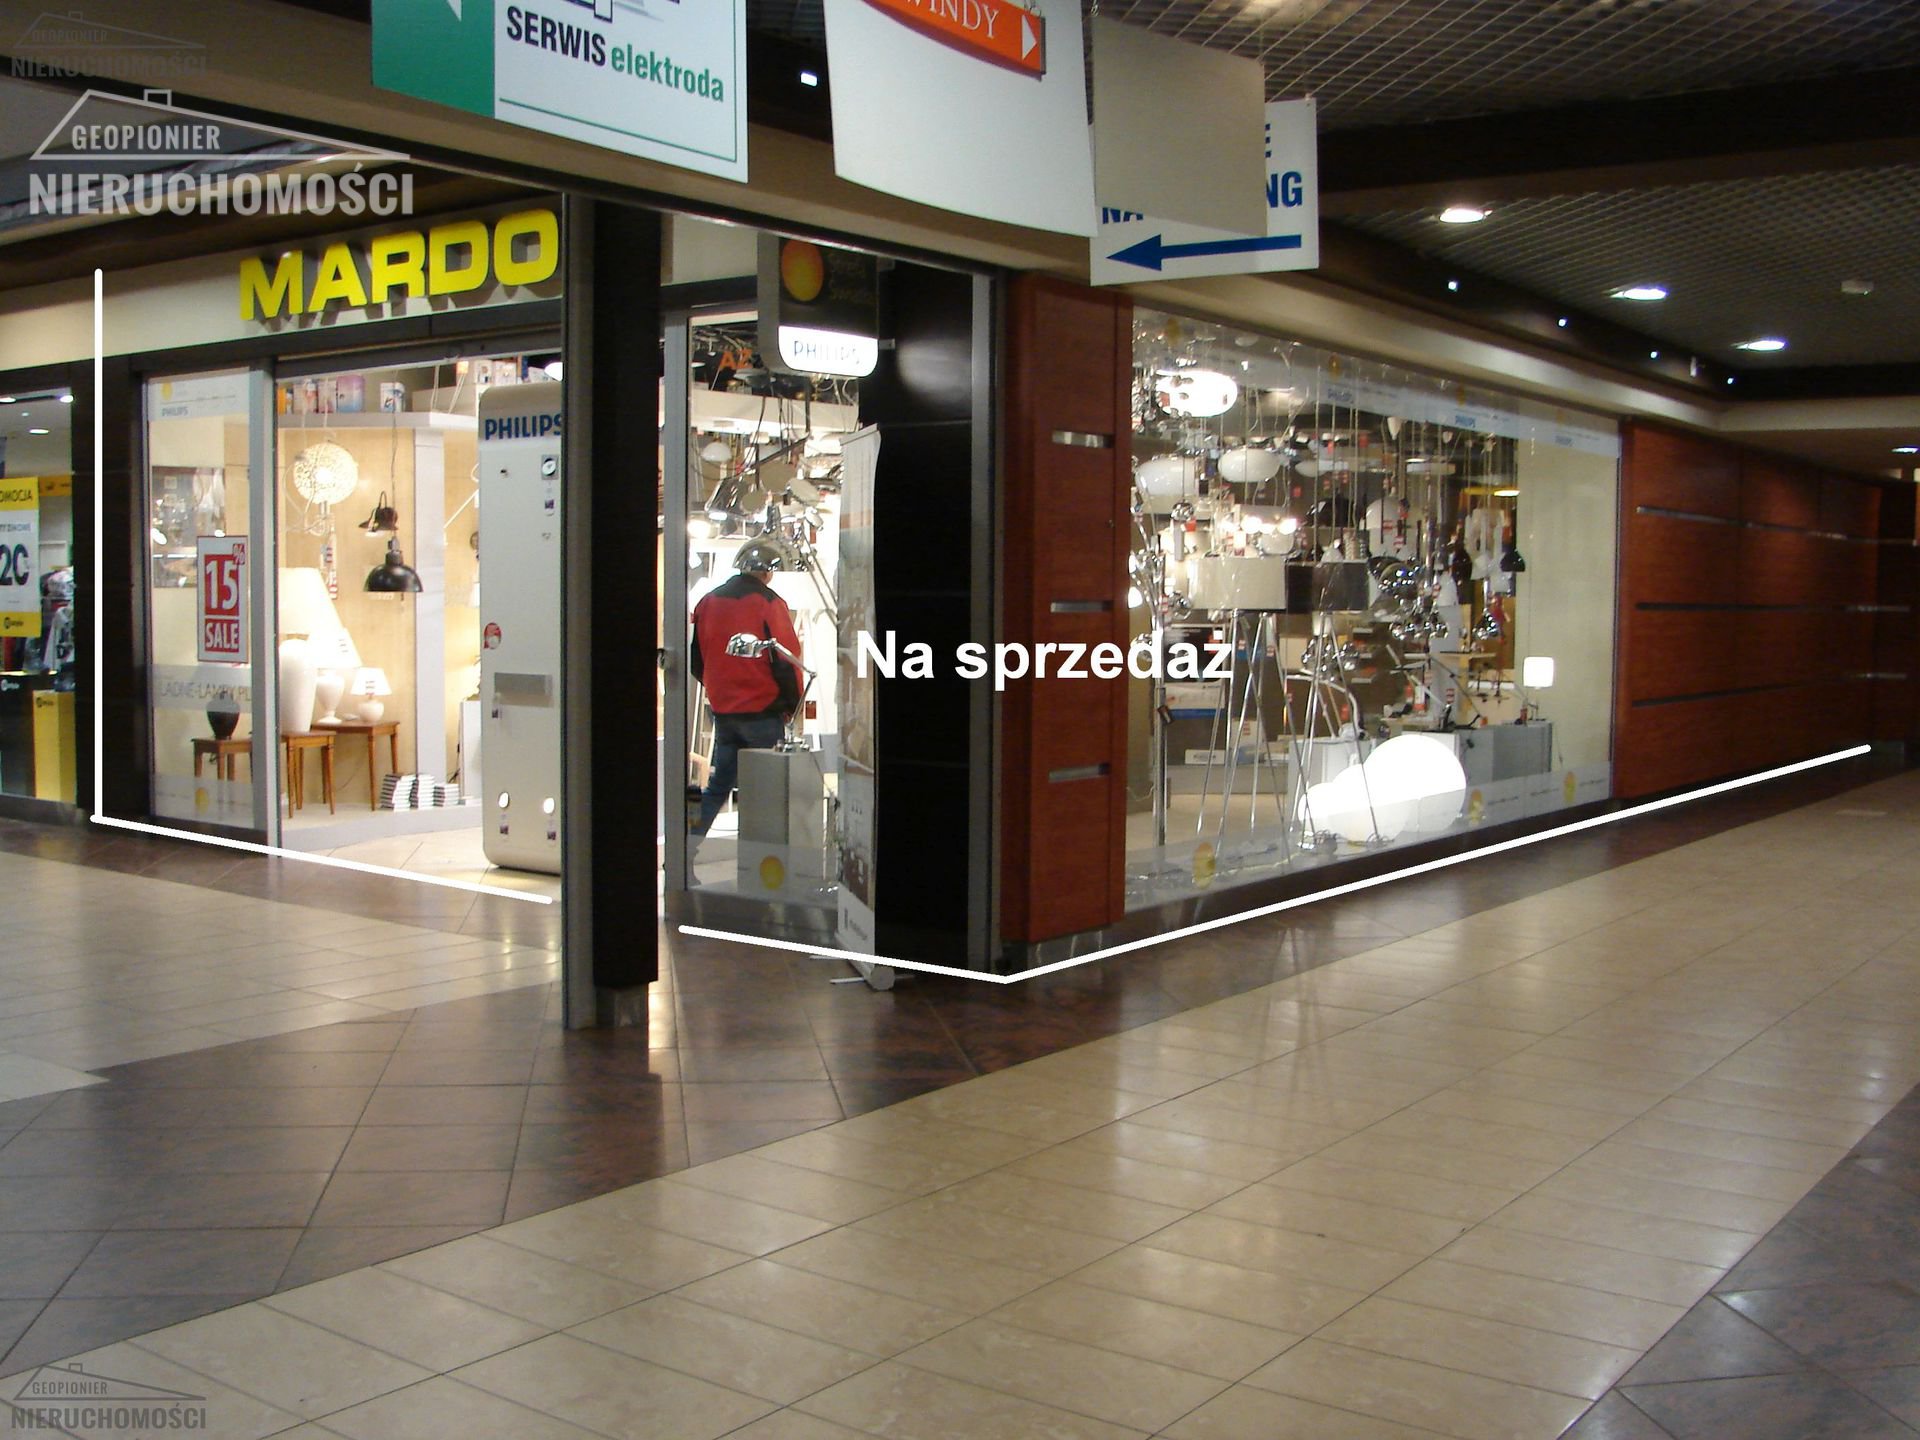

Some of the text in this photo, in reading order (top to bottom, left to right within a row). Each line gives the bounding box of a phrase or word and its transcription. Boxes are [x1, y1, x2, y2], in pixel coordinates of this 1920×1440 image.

[507, 6, 724, 102] SERWIS elektroda
[240, 209, 558, 321] MARDO
[485, 414, 562, 440] PHILIPS
[205, 622, 239, 649] SALE
